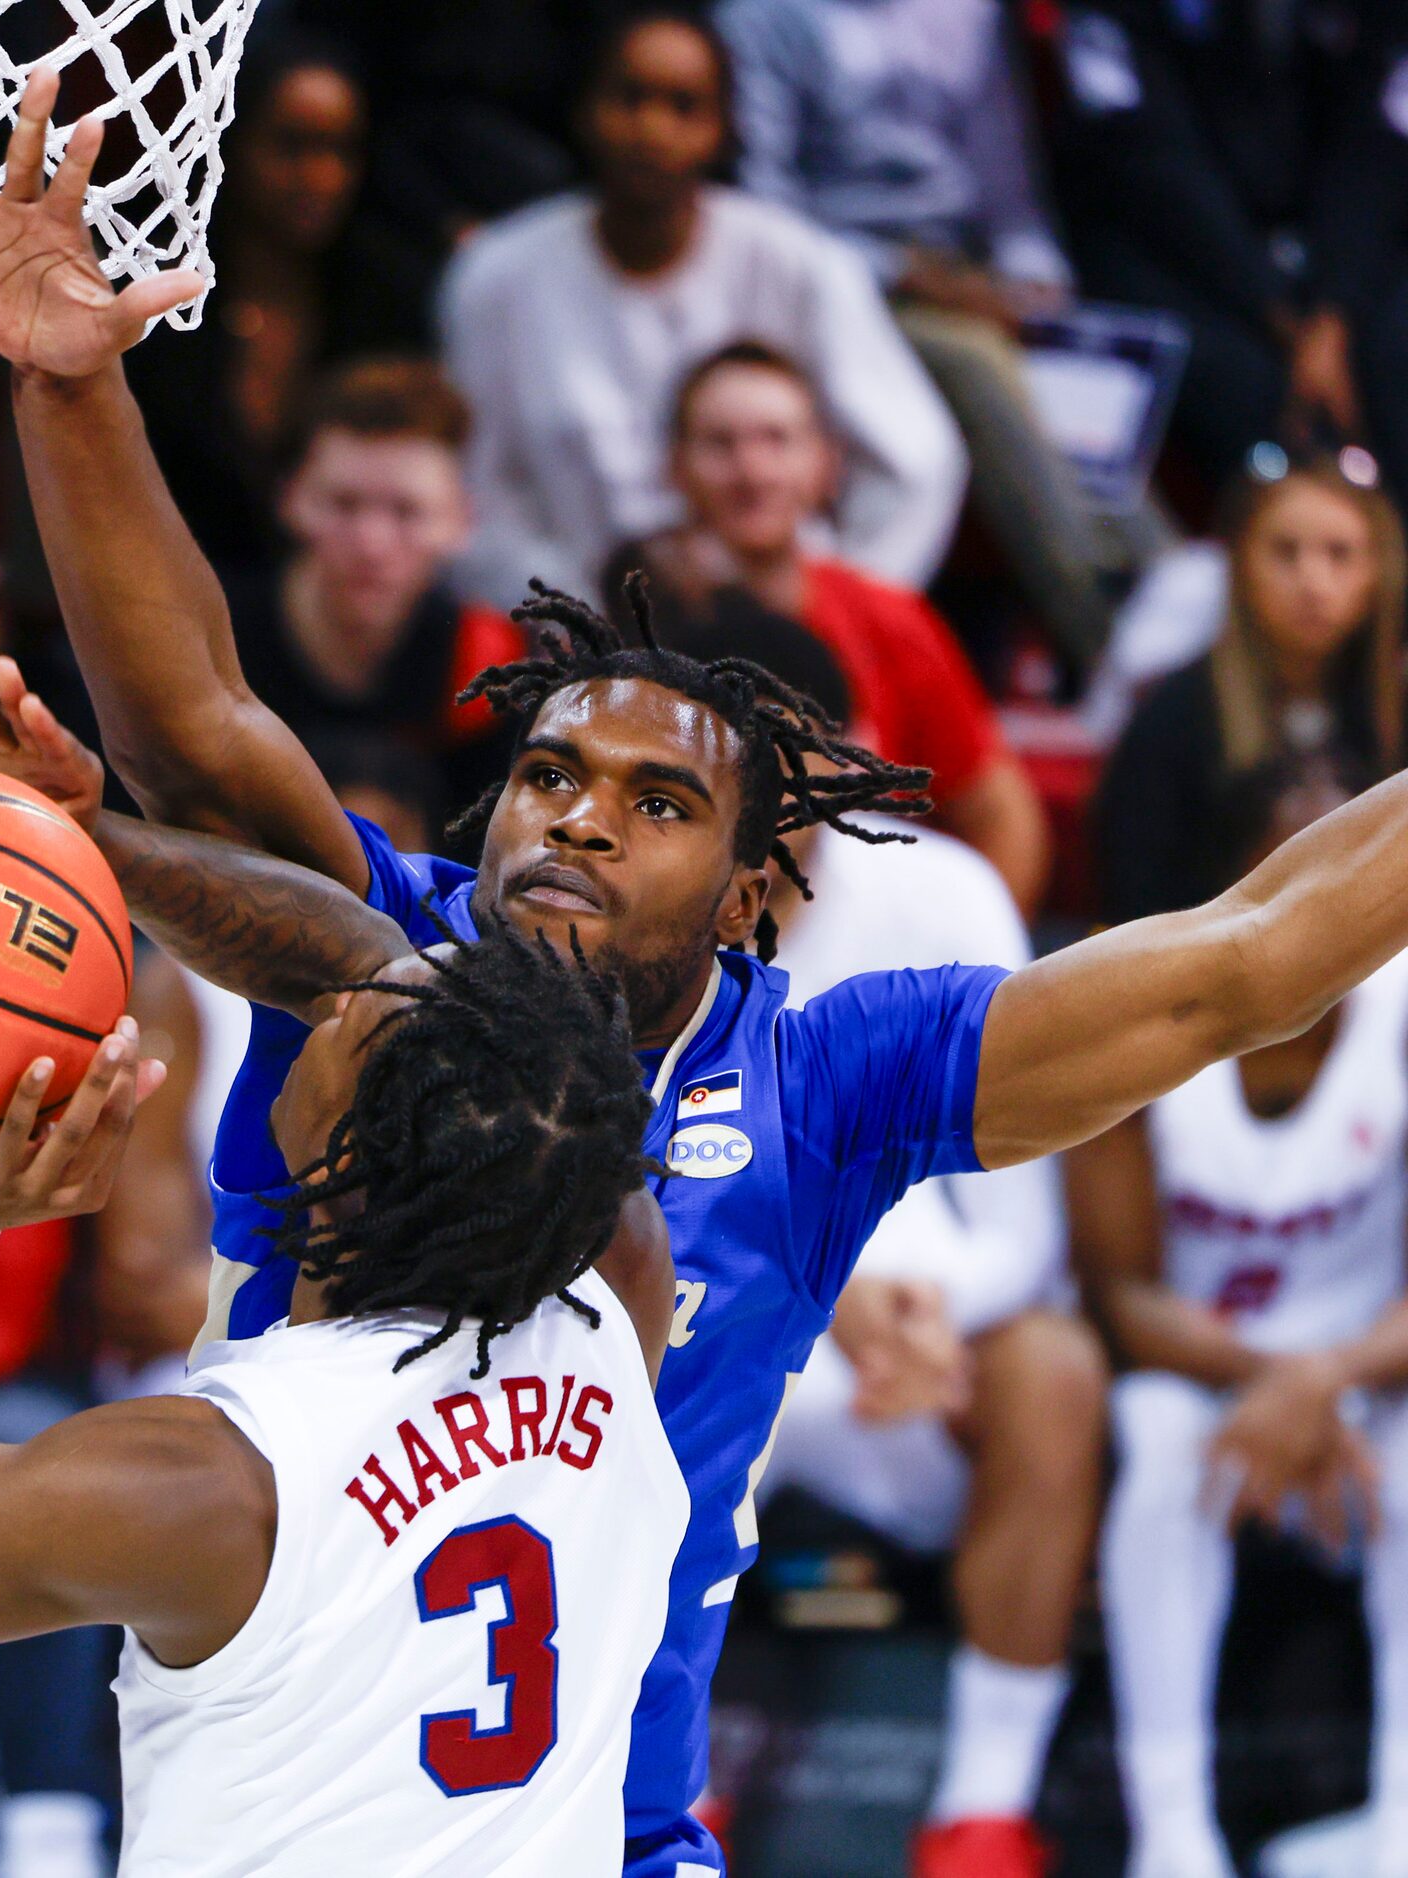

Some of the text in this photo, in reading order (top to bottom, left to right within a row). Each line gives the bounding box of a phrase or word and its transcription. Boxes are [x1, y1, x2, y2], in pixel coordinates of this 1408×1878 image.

[673, 1139, 747, 1162] DOC
[345, 1374, 613, 1547] HARRIS
[414, 1513, 559, 1799] 3
